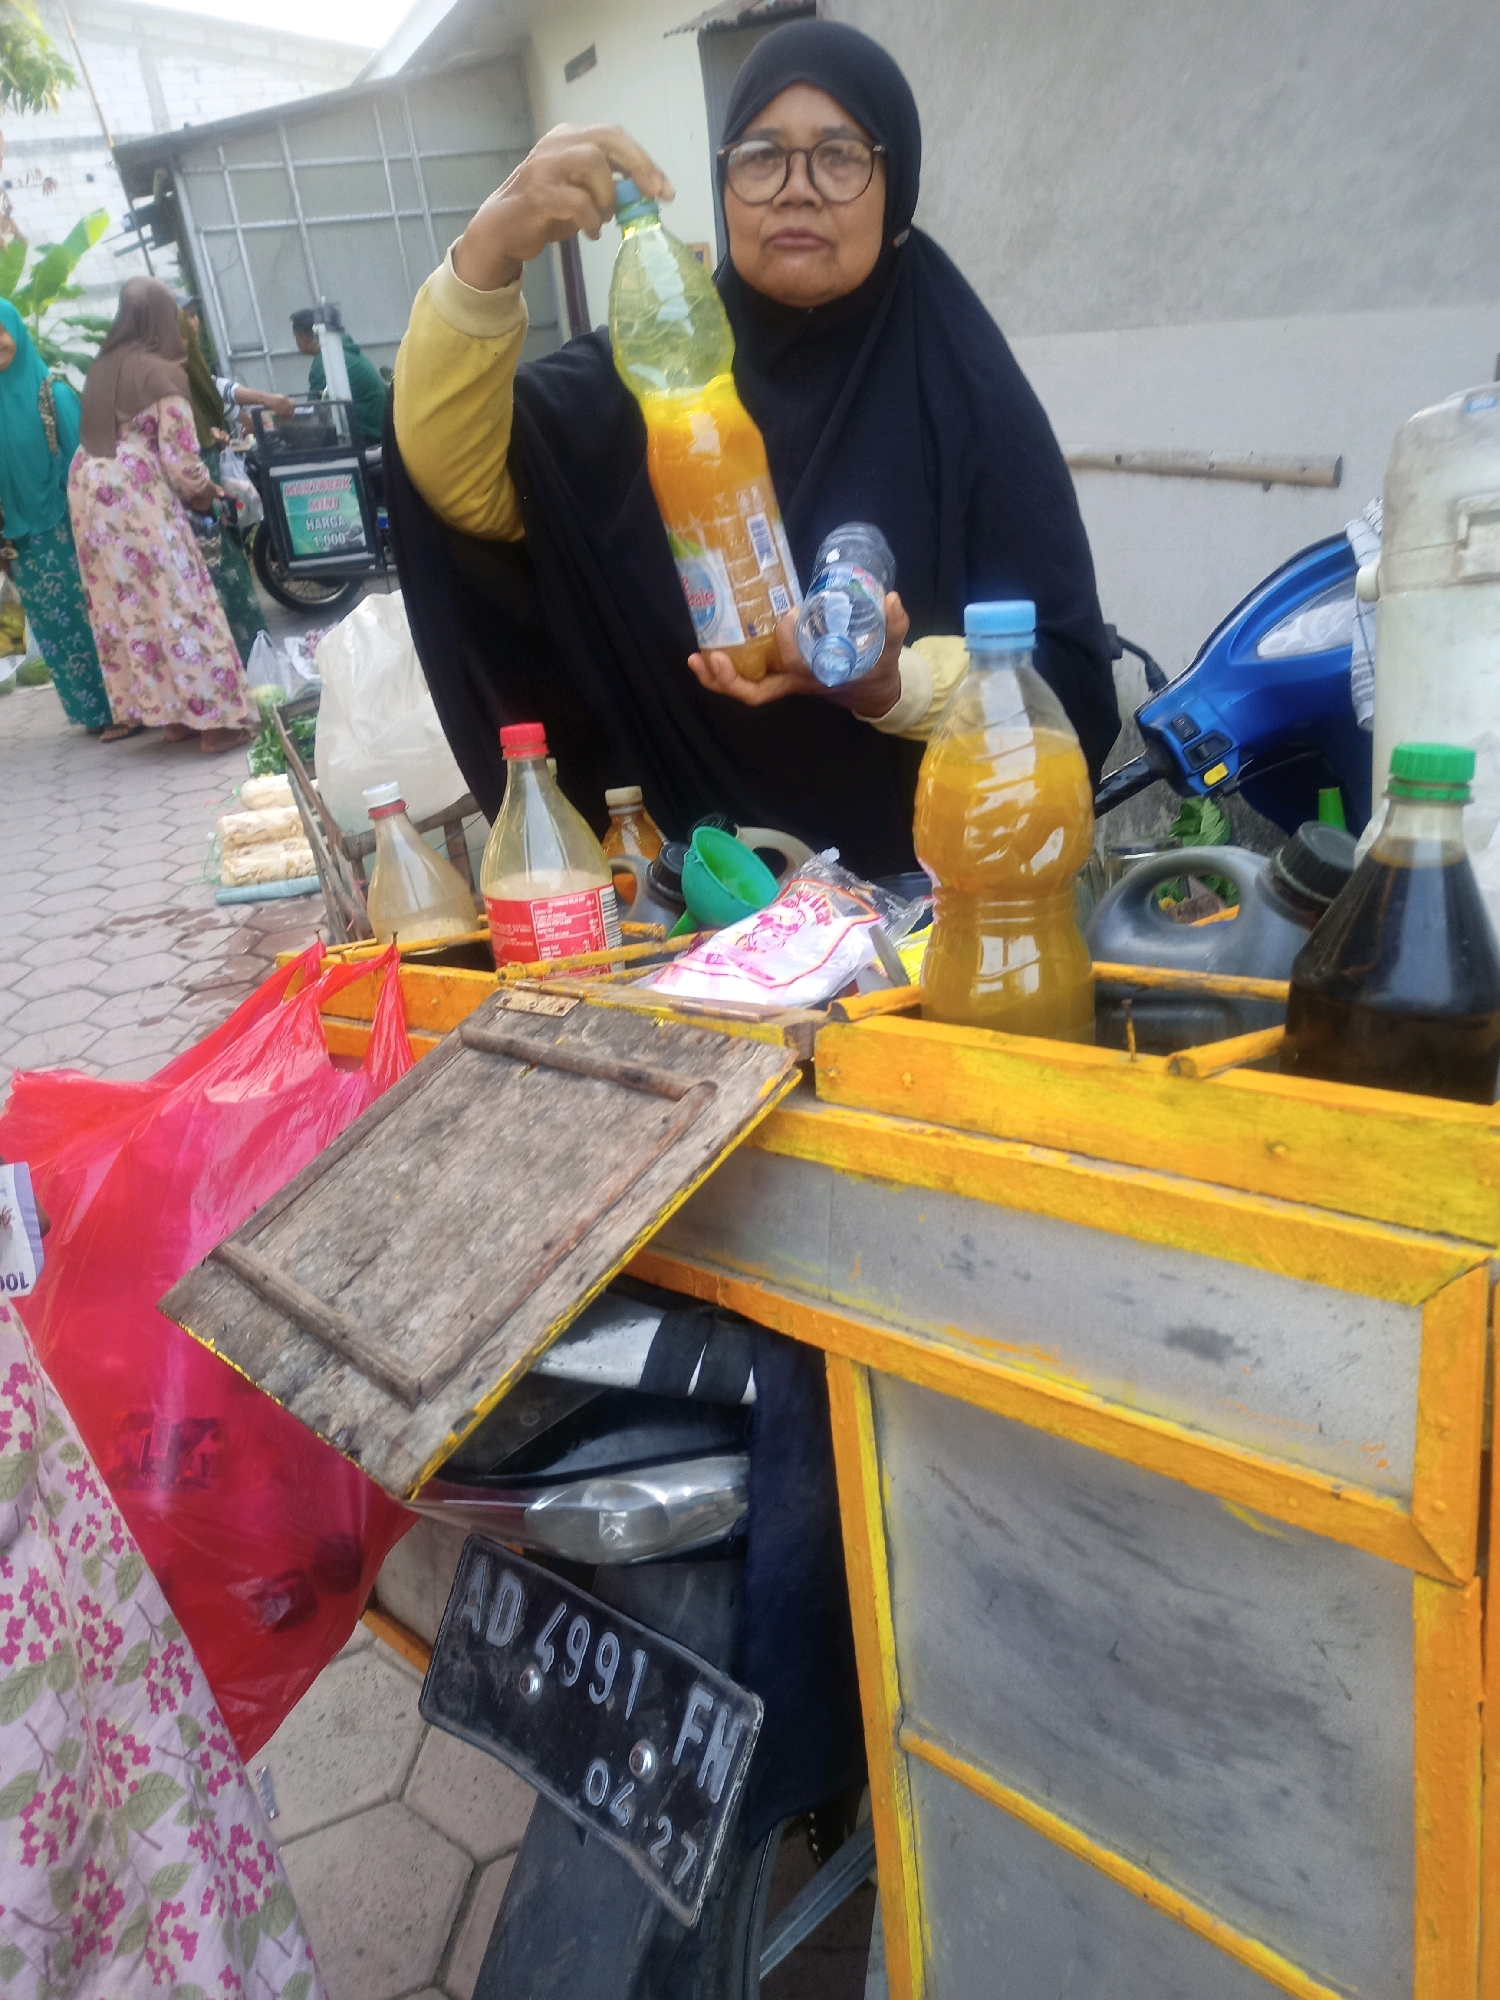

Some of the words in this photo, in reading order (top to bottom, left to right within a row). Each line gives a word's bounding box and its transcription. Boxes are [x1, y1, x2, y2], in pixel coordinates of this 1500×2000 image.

[284, 475, 352, 497] MARTABAK
[308, 497, 339, 512] MINI
[306, 515, 345, 530] HARGA
[457, 1557, 523, 1647] AD
[534, 1602, 648, 1721] 4991
